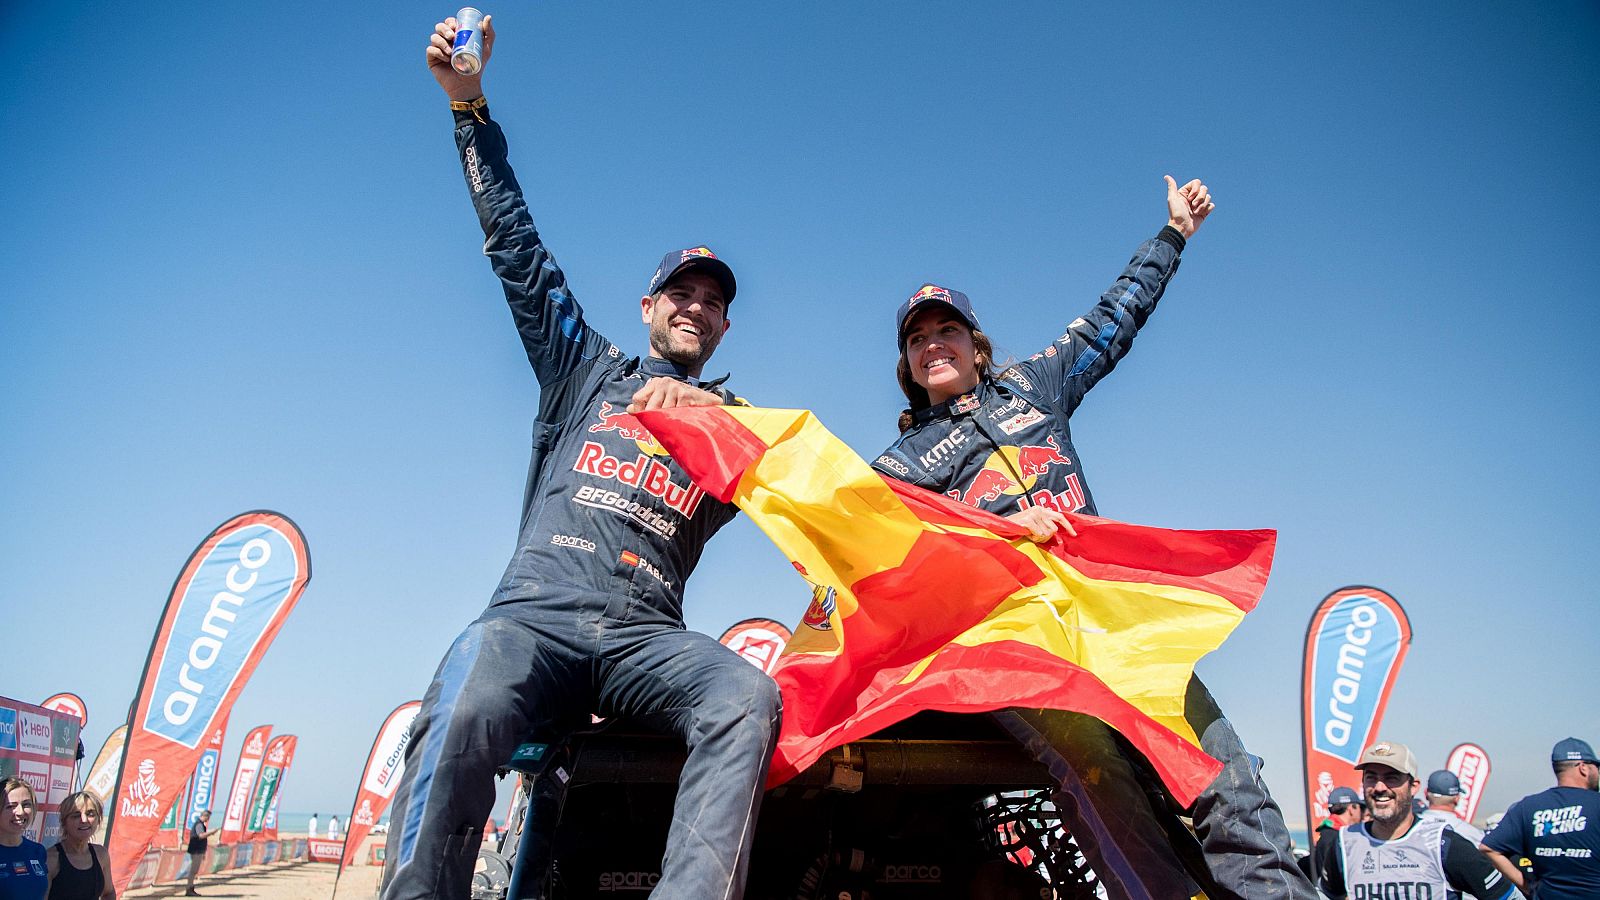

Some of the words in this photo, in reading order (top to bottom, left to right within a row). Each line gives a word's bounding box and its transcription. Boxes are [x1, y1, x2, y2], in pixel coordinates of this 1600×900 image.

[466, 146, 483, 193] sparco
[1008, 367, 1033, 391] sparc
[876, 455, 909, 476] sparco
[573, 440, 650, 489] Red
[641, 458, 706, 520] Bull
[573, 485, 677, 538] BFGoodrich
[551, 534, 597, 552] sparco
[164, 538, 272, 726] aramco
[1325, 604, 1378, 748] aramco
[230, 770, 254, 819] MOTUL
[1532, 805, 1583, 825] SOUTH
[316, 843, 344, 856] MOTU
[599, 871, 659, 892] sparc
[881, 863, 941, 883] parco
